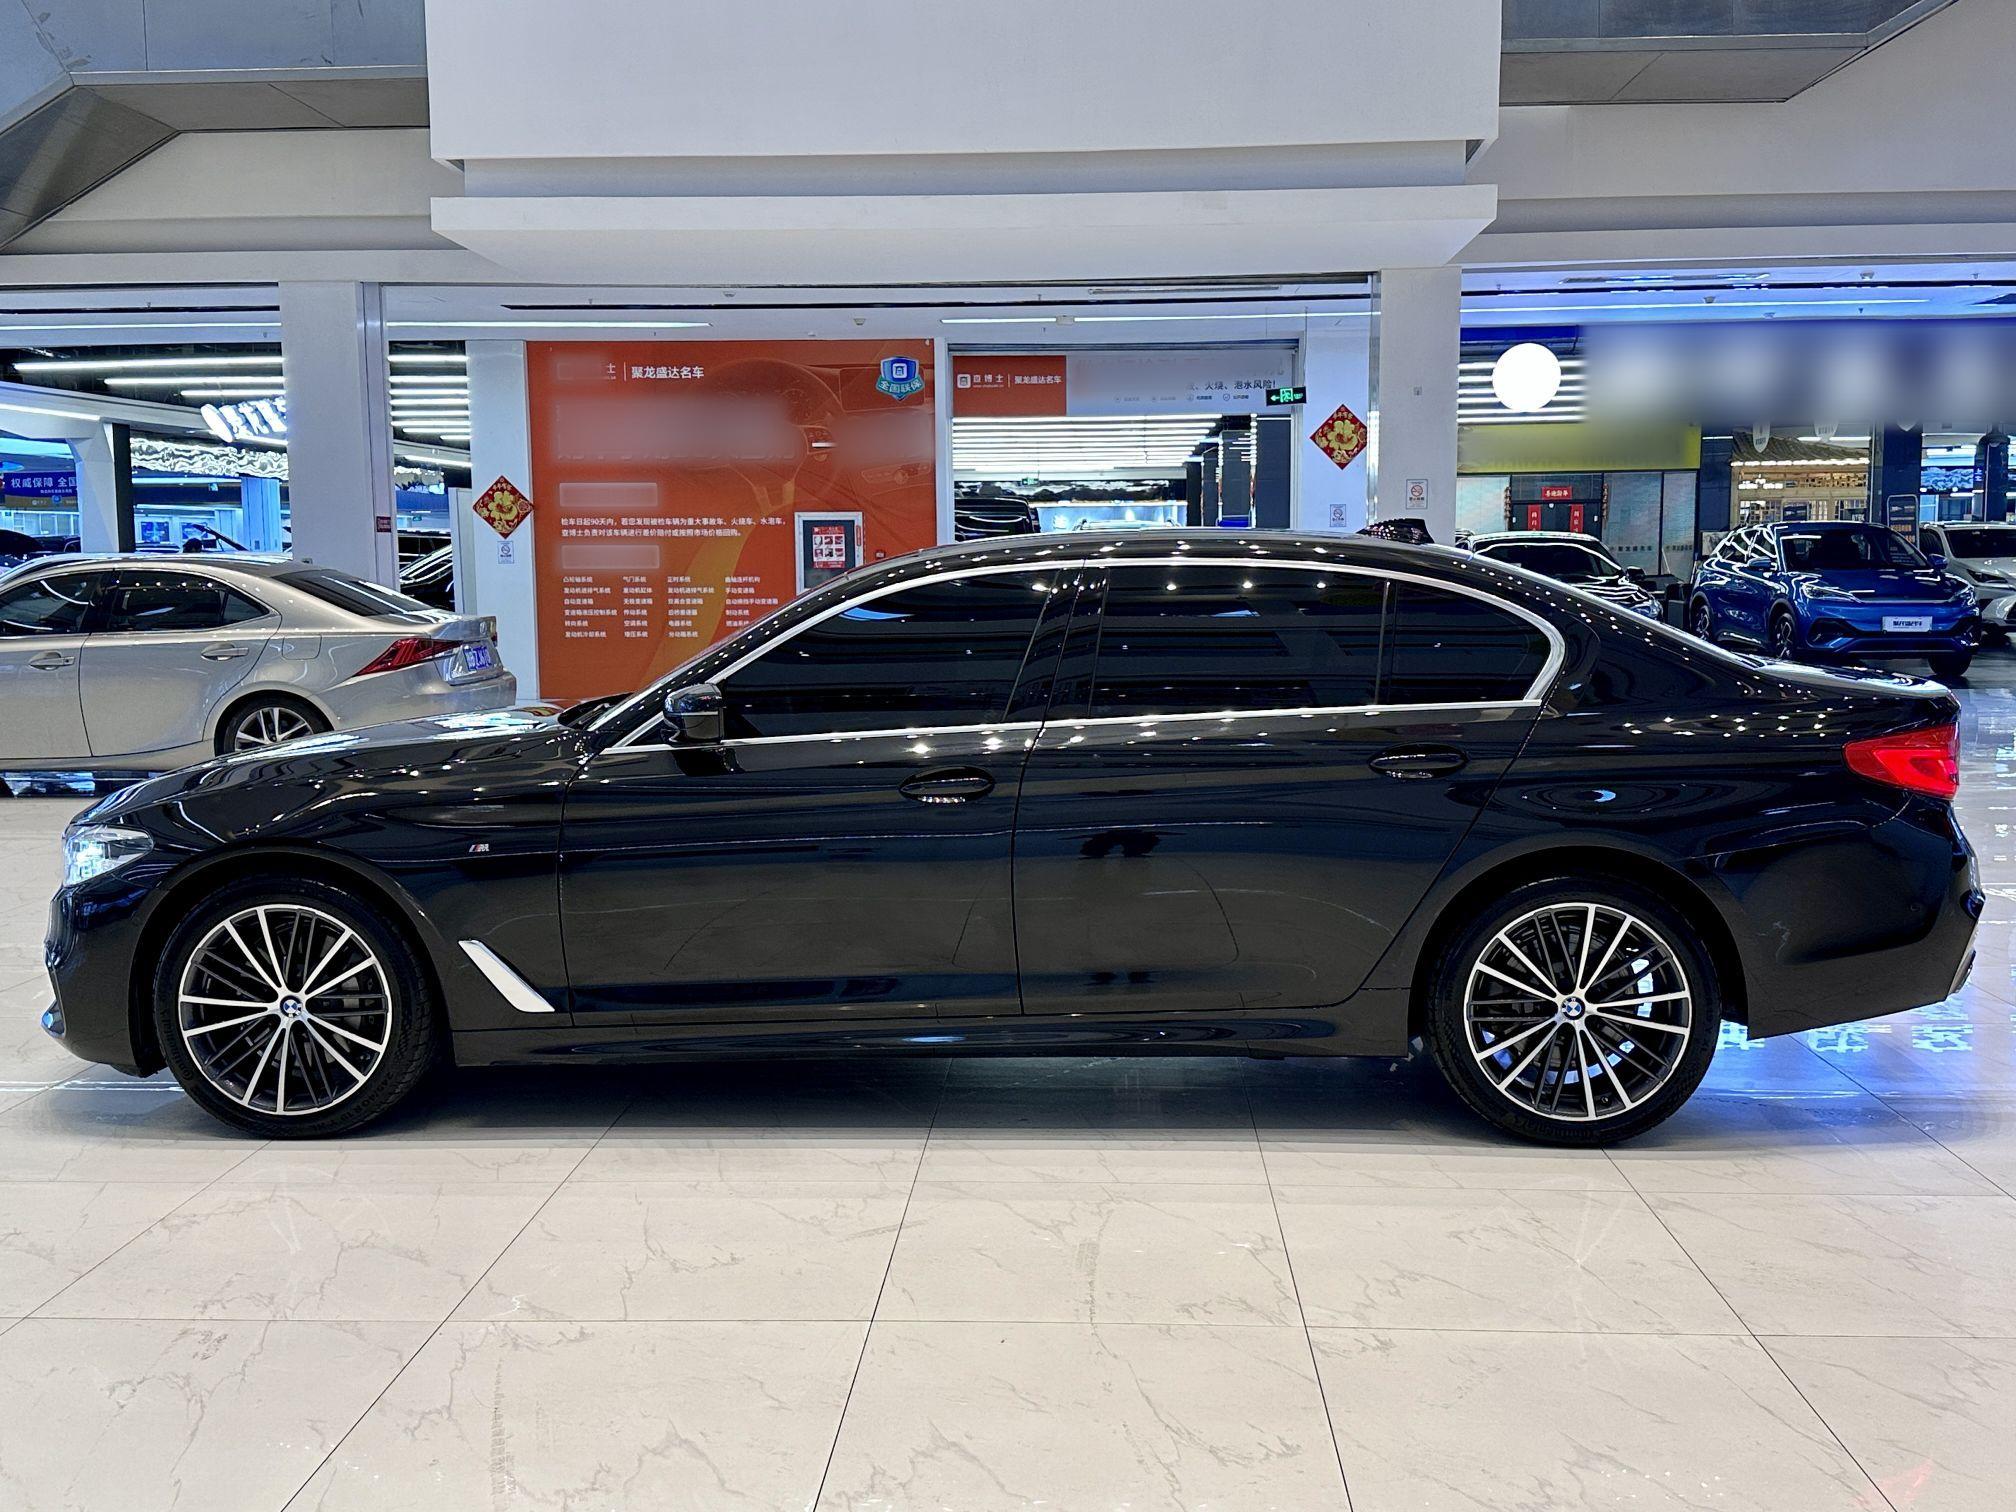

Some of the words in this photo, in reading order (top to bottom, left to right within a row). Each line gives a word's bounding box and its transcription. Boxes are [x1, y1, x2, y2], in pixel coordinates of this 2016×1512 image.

[631, 366, 705, 379] 聚龙盛达名车
[1014, 375, 1062, 384] 聚龙盛达名车
[879, 379, 922, 393] 全国联保
[11, 477, 53, 488] 权威保障
[57, 476, 77, 488] 全国
